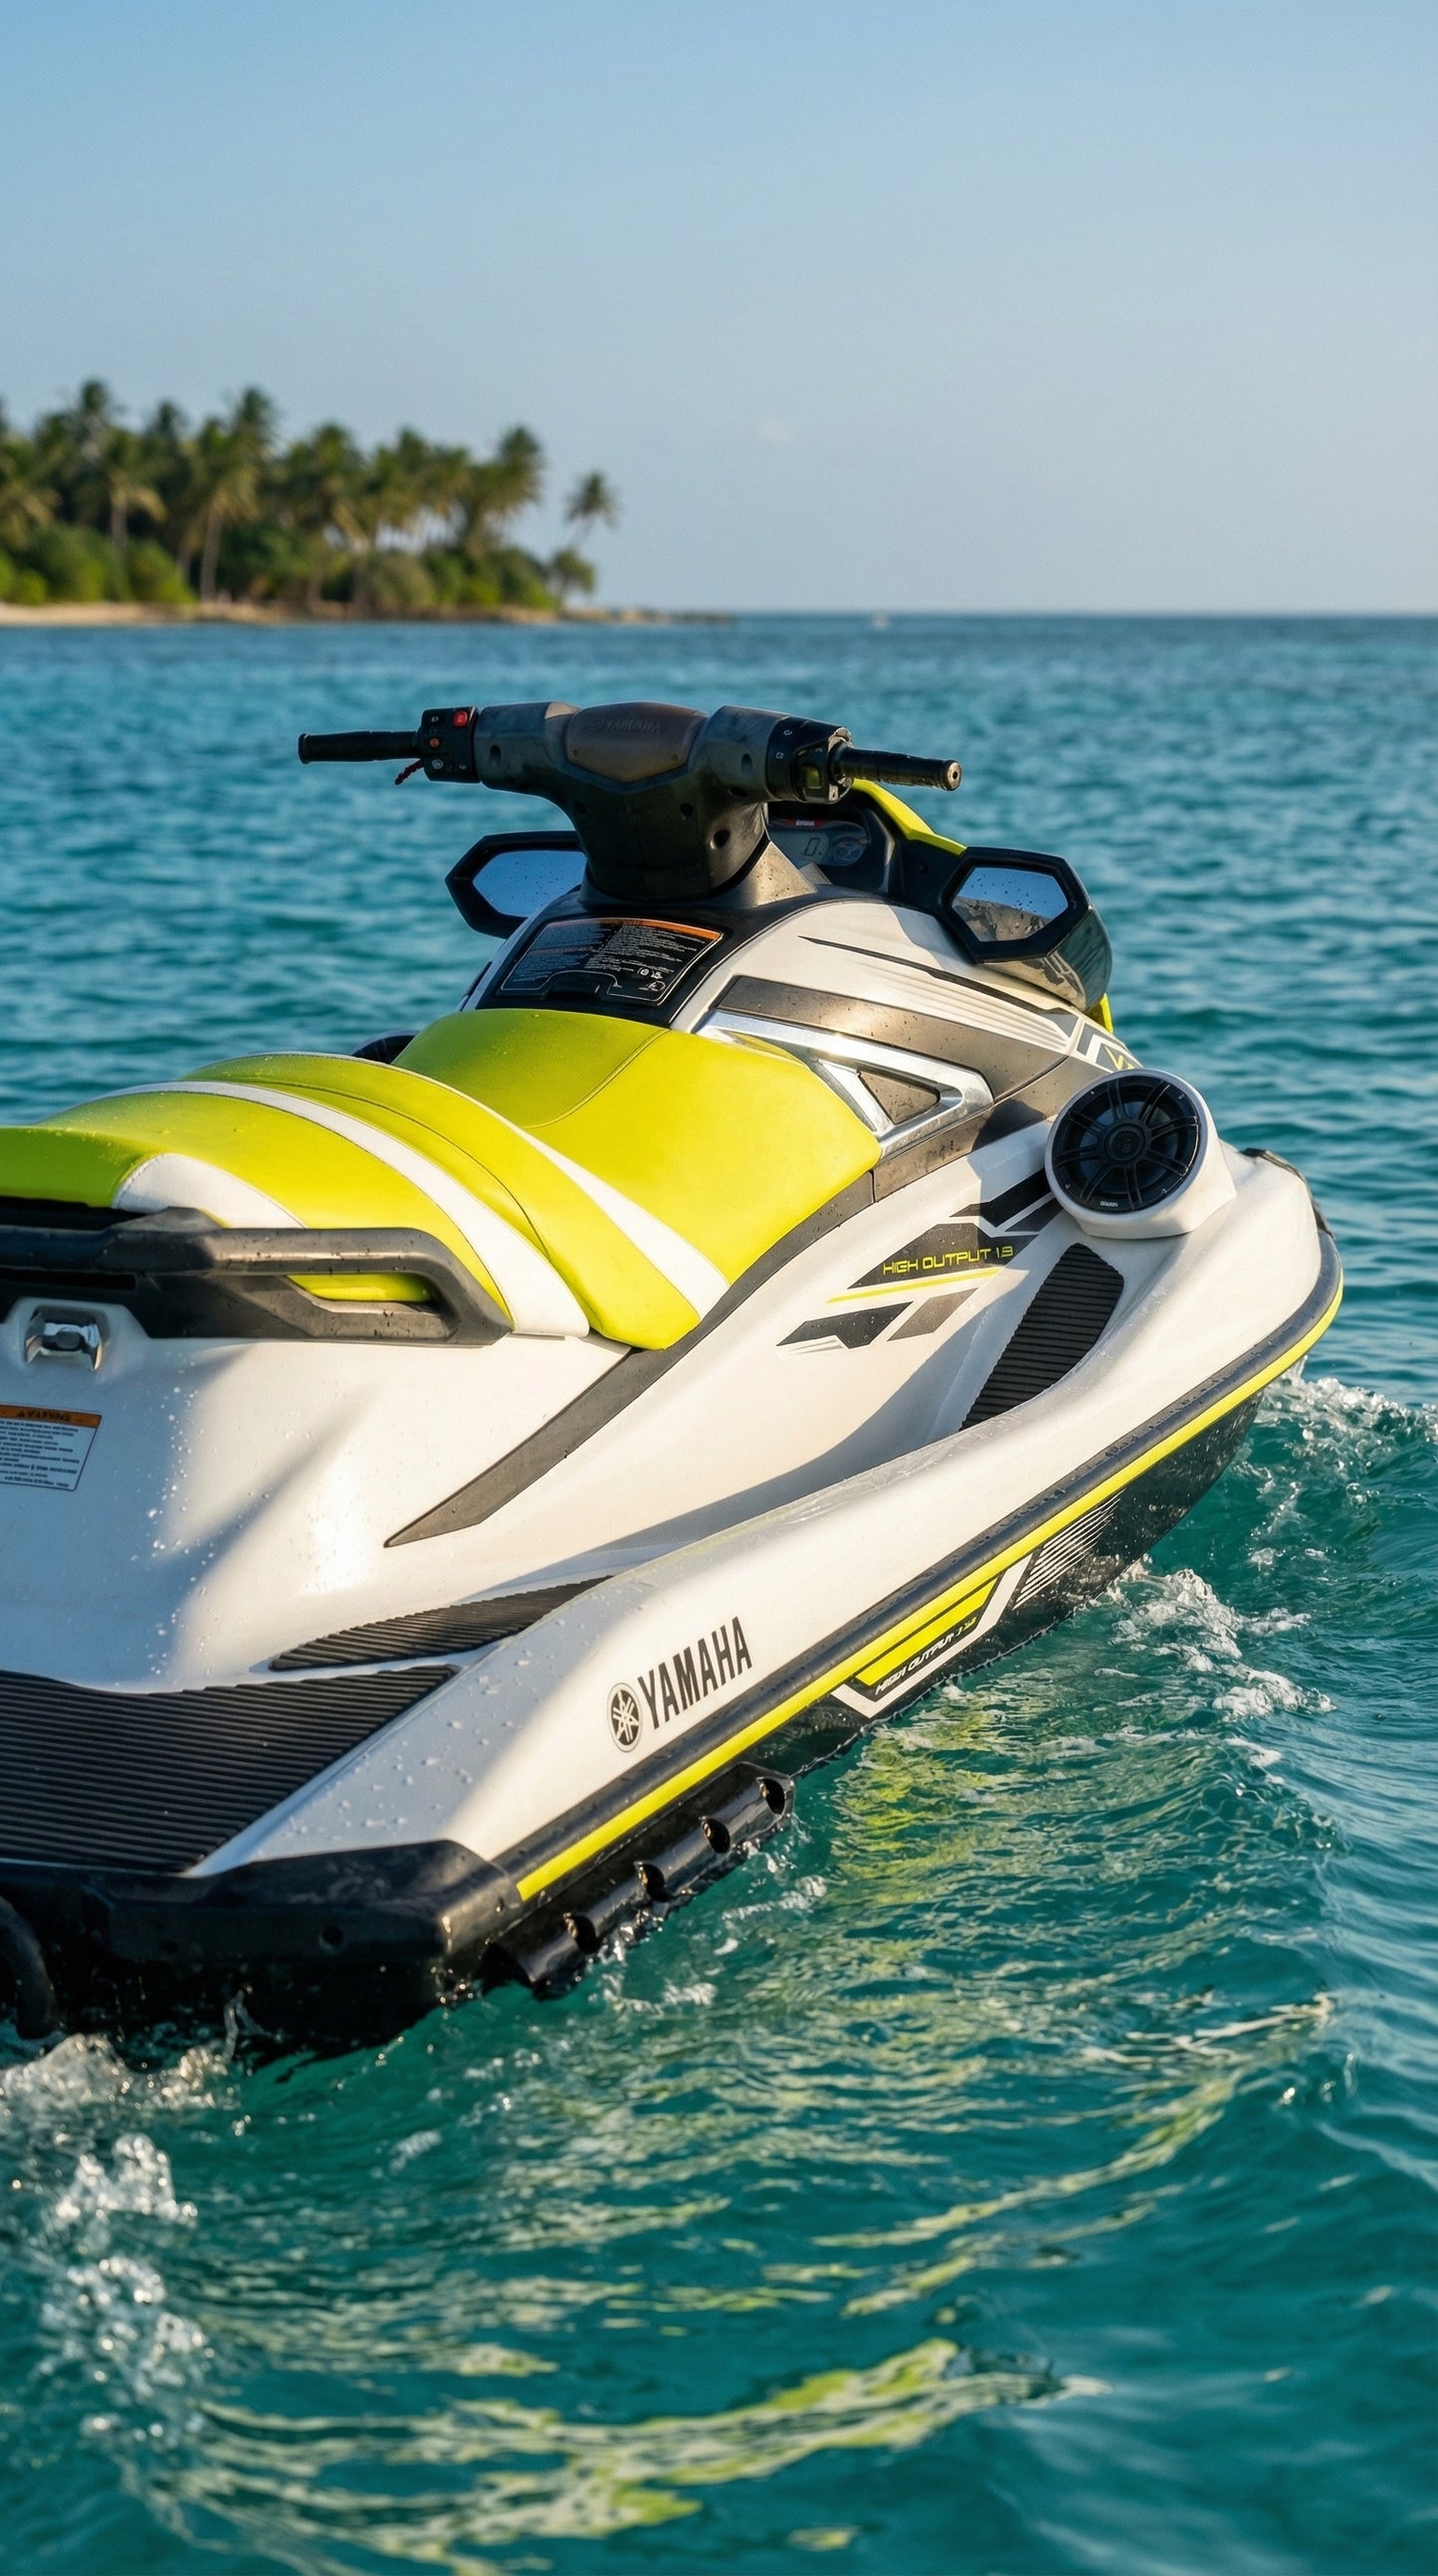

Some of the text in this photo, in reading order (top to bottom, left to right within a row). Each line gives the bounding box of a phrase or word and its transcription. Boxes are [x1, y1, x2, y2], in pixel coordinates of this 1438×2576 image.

[883, 1259, 919, 1276] HIGH
[922, 1248, 992, 1270] OUTPUT
[637, 1616, 752, 1730] YAMAHA
